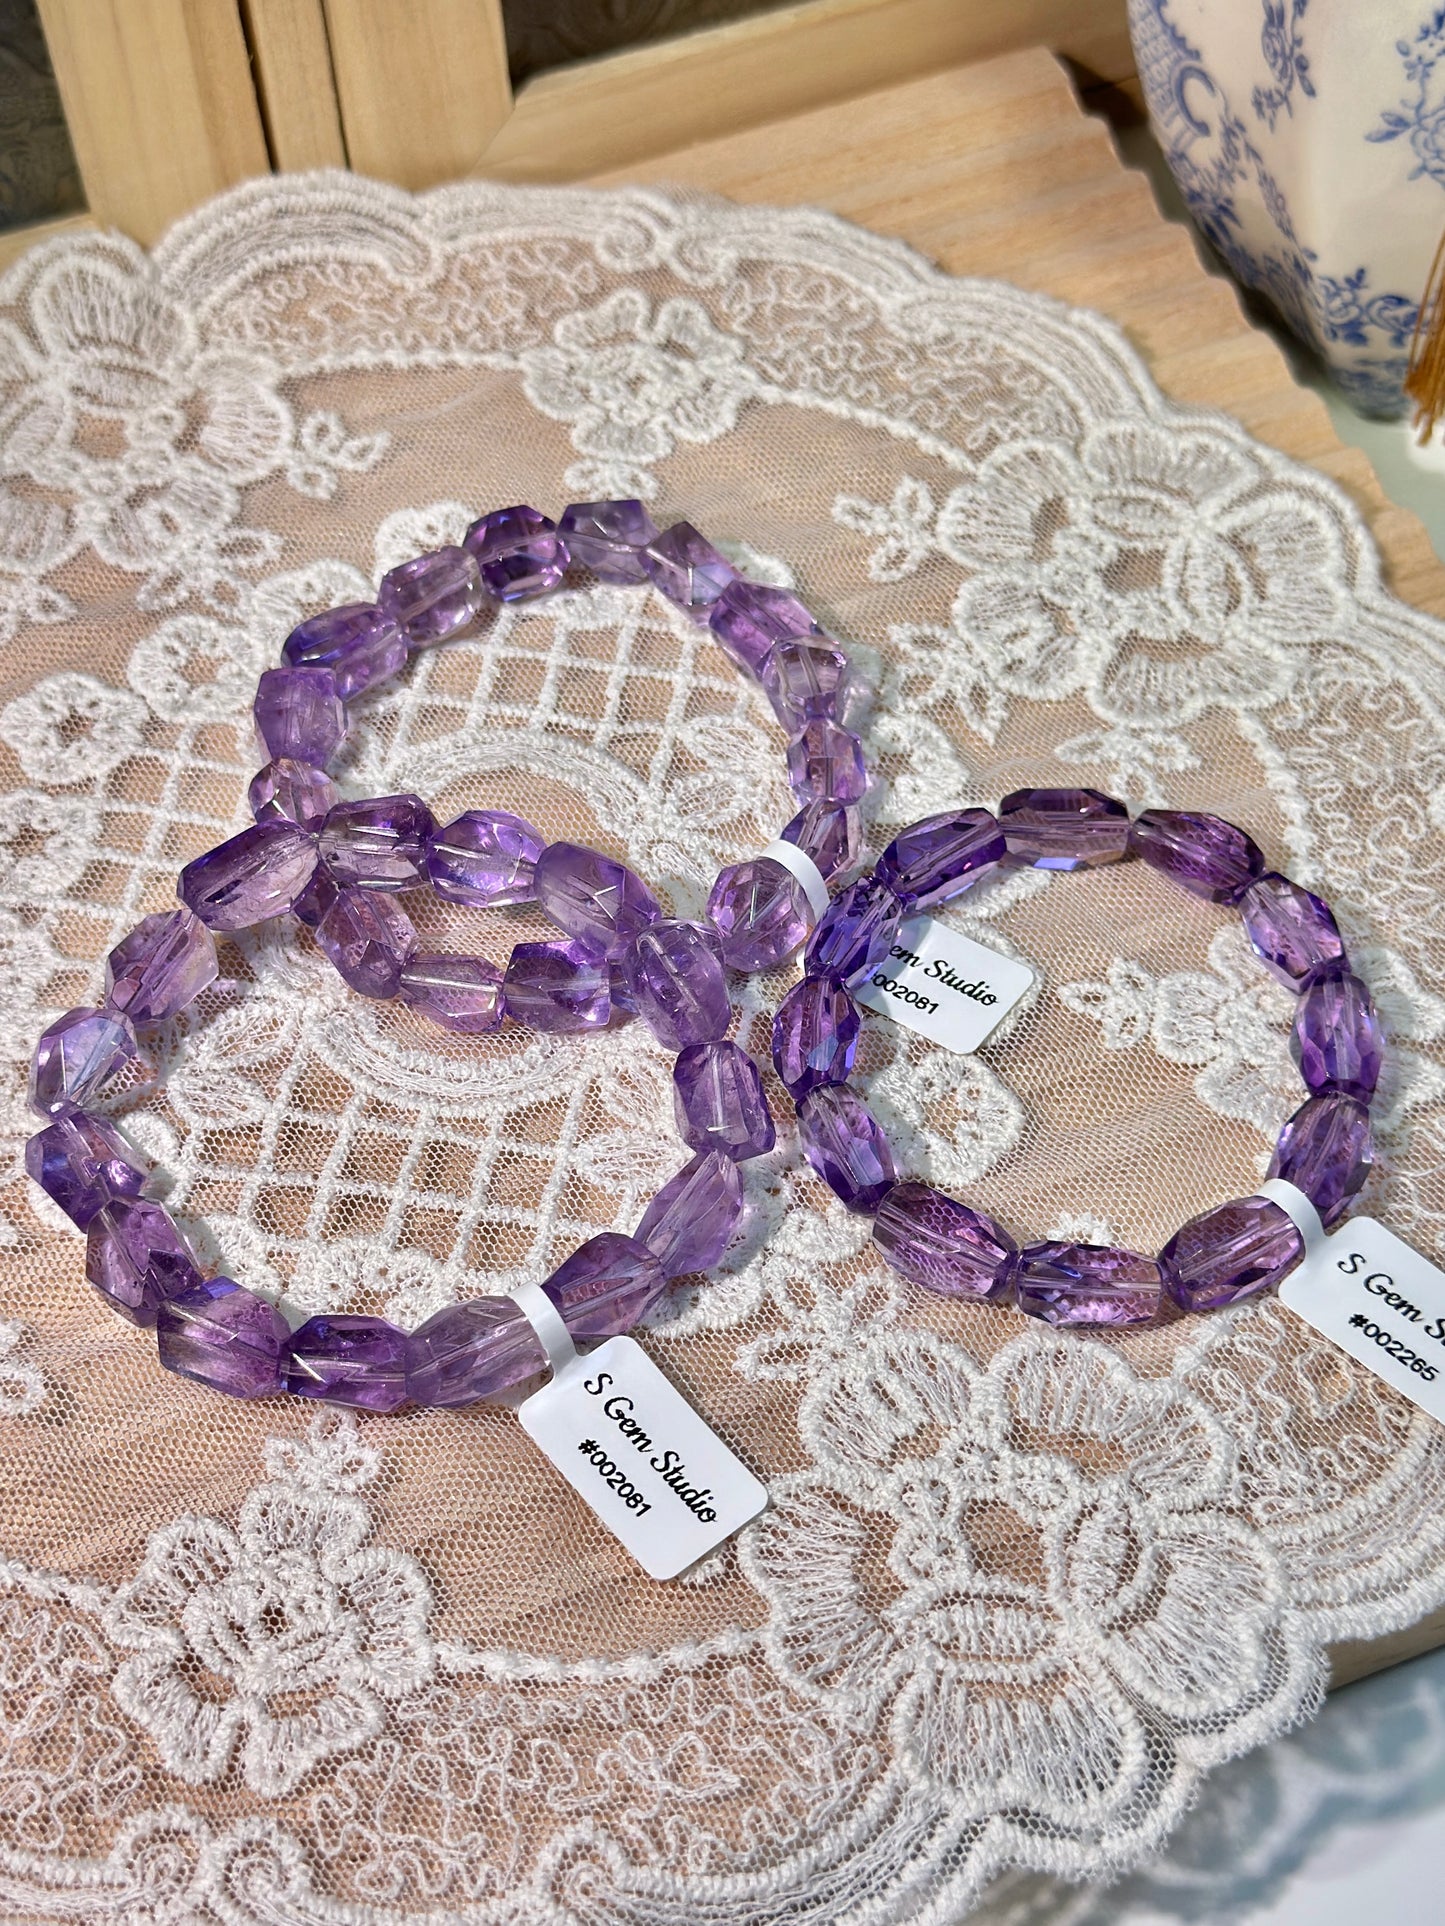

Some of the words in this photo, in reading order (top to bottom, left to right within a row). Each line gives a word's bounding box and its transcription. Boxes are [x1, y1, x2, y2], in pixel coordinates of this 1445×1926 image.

[871, 972, 940, 1014] 002081
[889, 944, 924, 968] em
[924, 959, 1000, 1007] Studio
[1337, 1252, 1366, 1275] S
[1363, 1273, 1424, 1322] Gem
[1348, 1313, 1439, 1382] #002265
[578, 1439, 652, 1517] #002081
[583, 1373, 614, 1396] S
[604, 1396, 654, 1453] Gem
[650, 1450, 718, 1523] Studio
